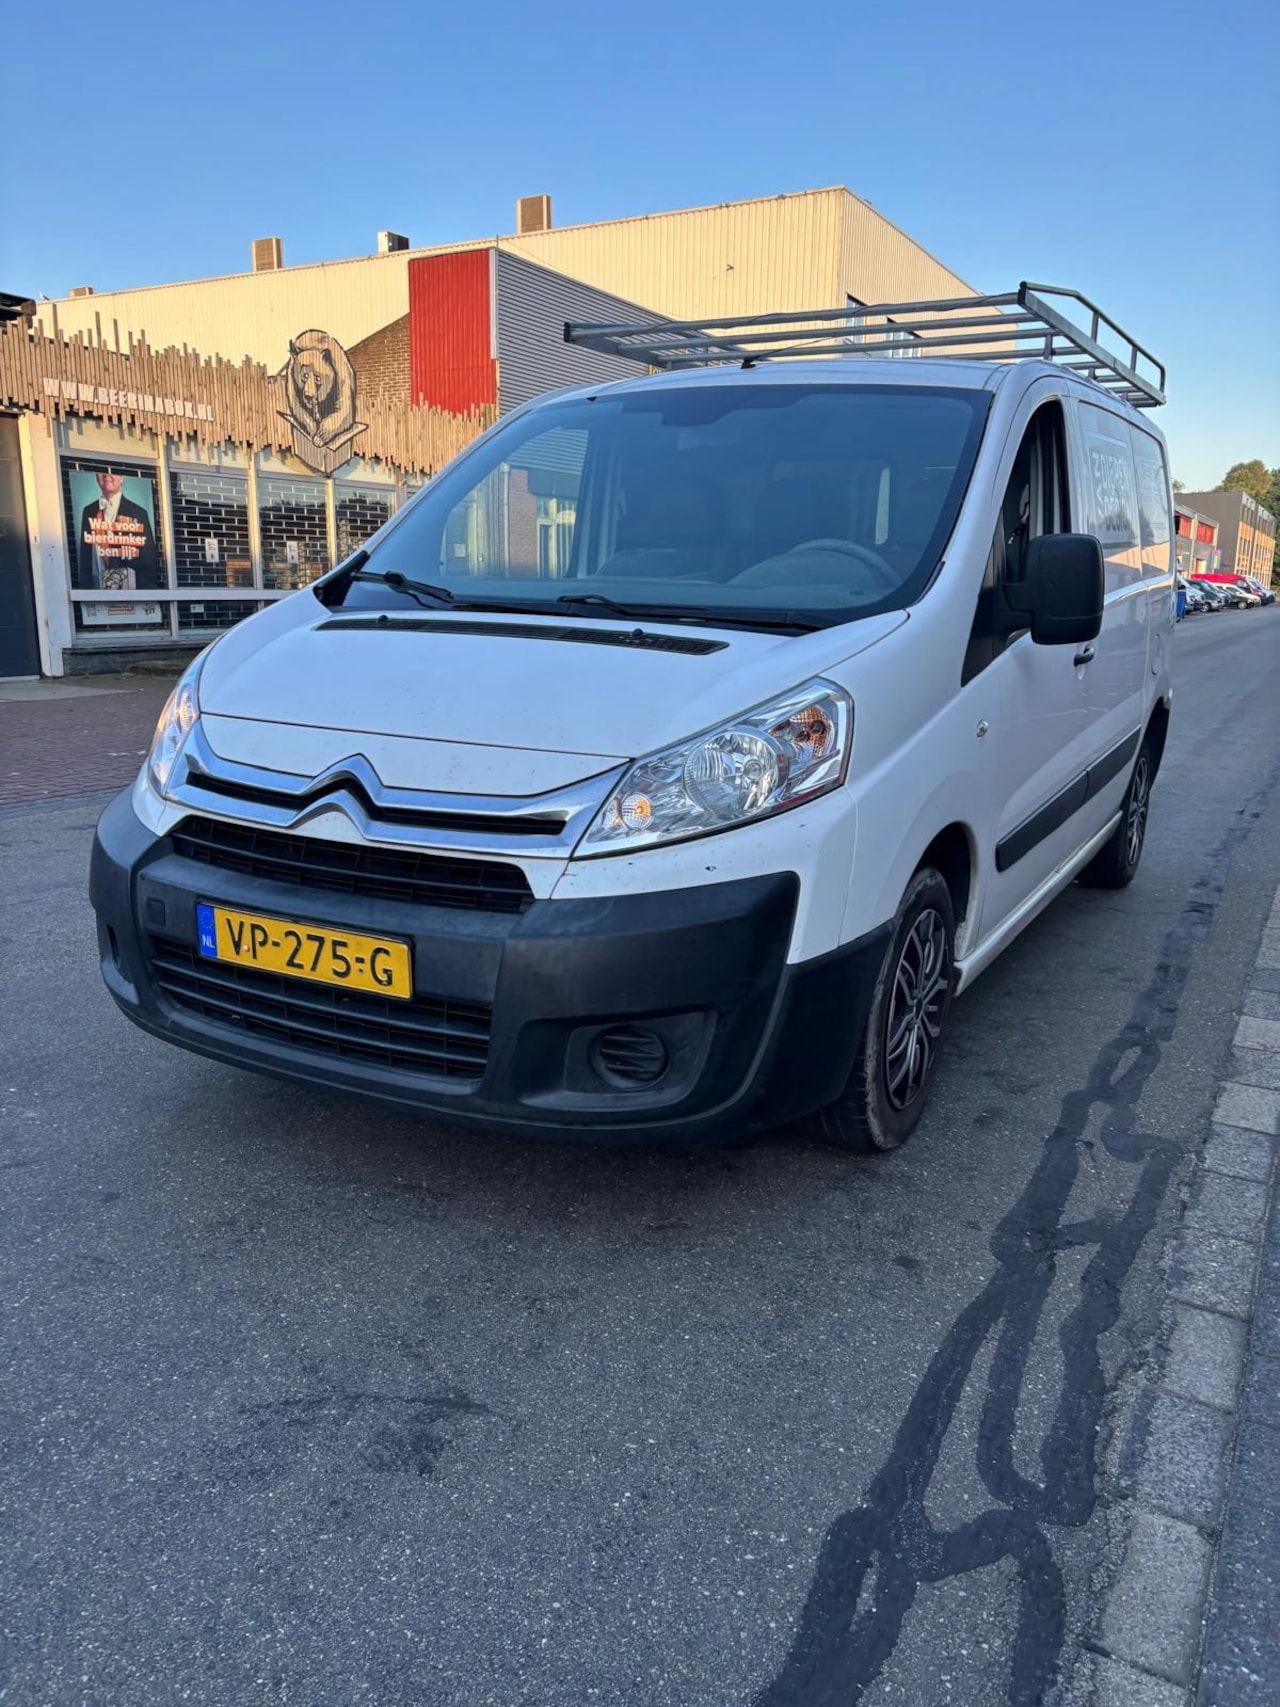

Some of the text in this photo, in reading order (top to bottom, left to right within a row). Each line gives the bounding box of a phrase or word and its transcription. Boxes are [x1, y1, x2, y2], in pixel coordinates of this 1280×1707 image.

[43, 377, 214, 421] WWW.BEERINABOX.NL
[88, 517, 140, 531] Wat voor
[84, 531, 146, 545] bierdrinker
[98, 546, 137, 560] ben jij?
[202, 934, 215, 949] NL
[226, 918, 393, 986] VP-275-G
